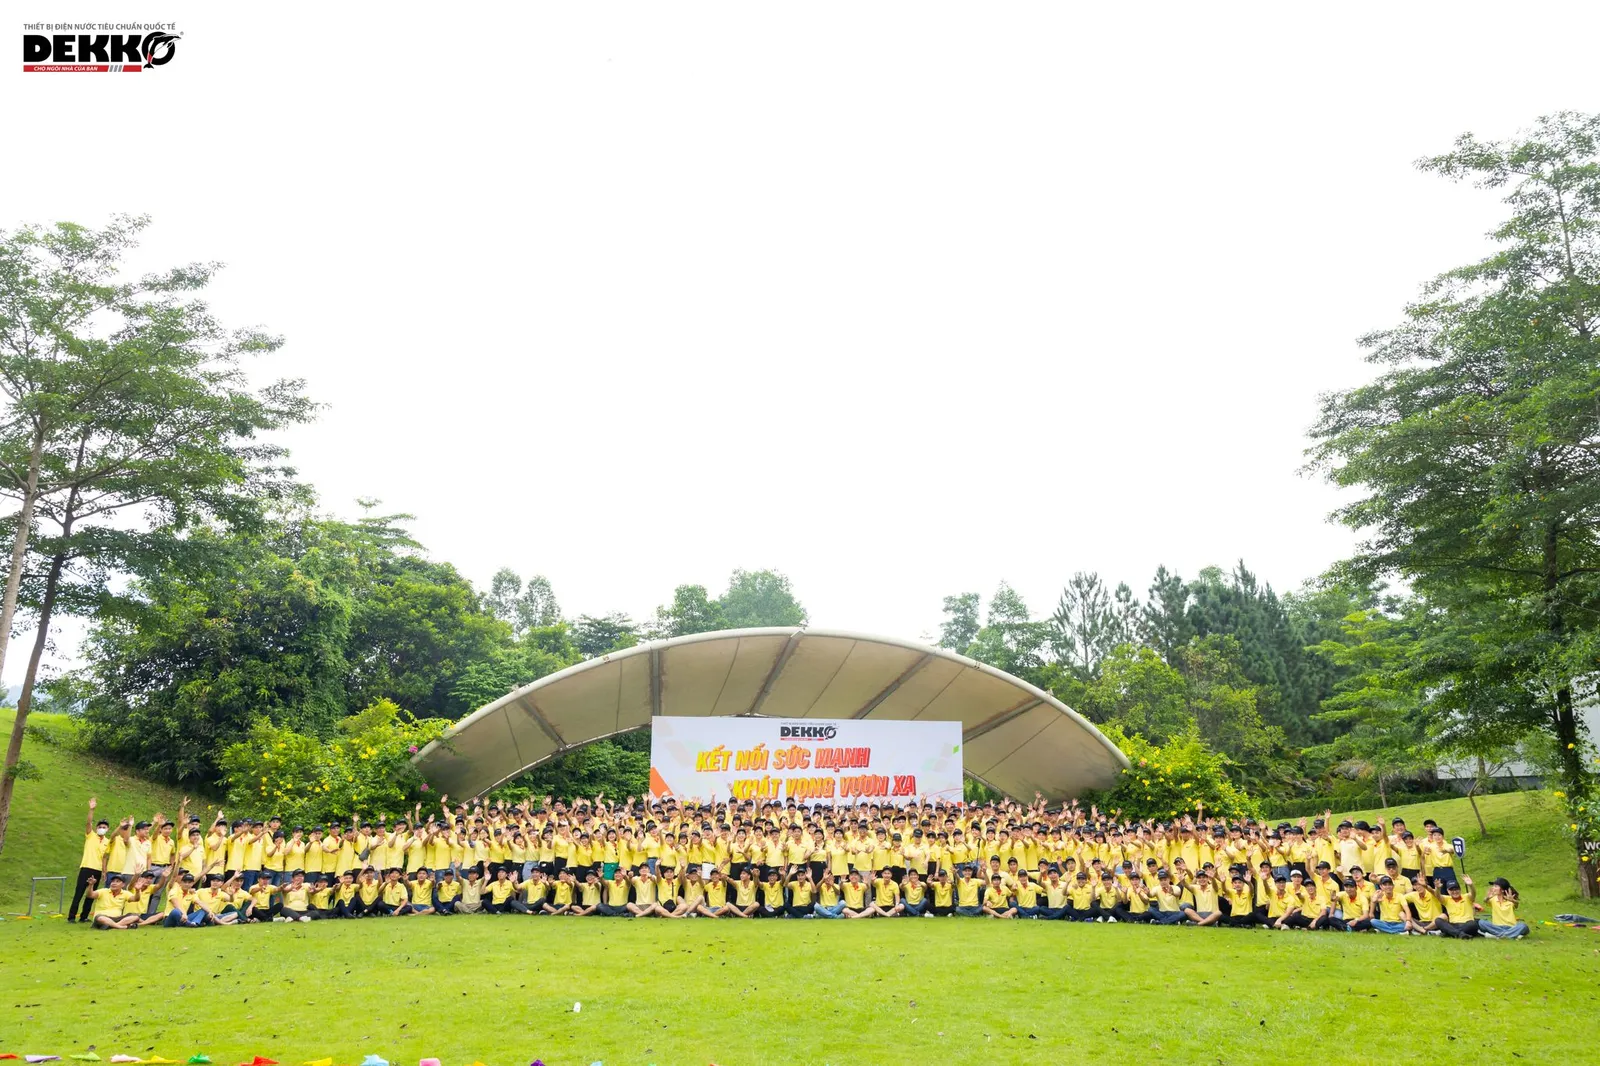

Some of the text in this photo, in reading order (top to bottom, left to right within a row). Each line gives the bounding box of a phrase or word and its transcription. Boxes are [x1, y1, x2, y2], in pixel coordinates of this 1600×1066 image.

[780, 726, 838, 740] DEKKO
[695, 743, 871, 773] KẾT NỐI SỨC MẠNH
[732, 774, 917, 803] KHÁT VỌNG VƯƠN XA
